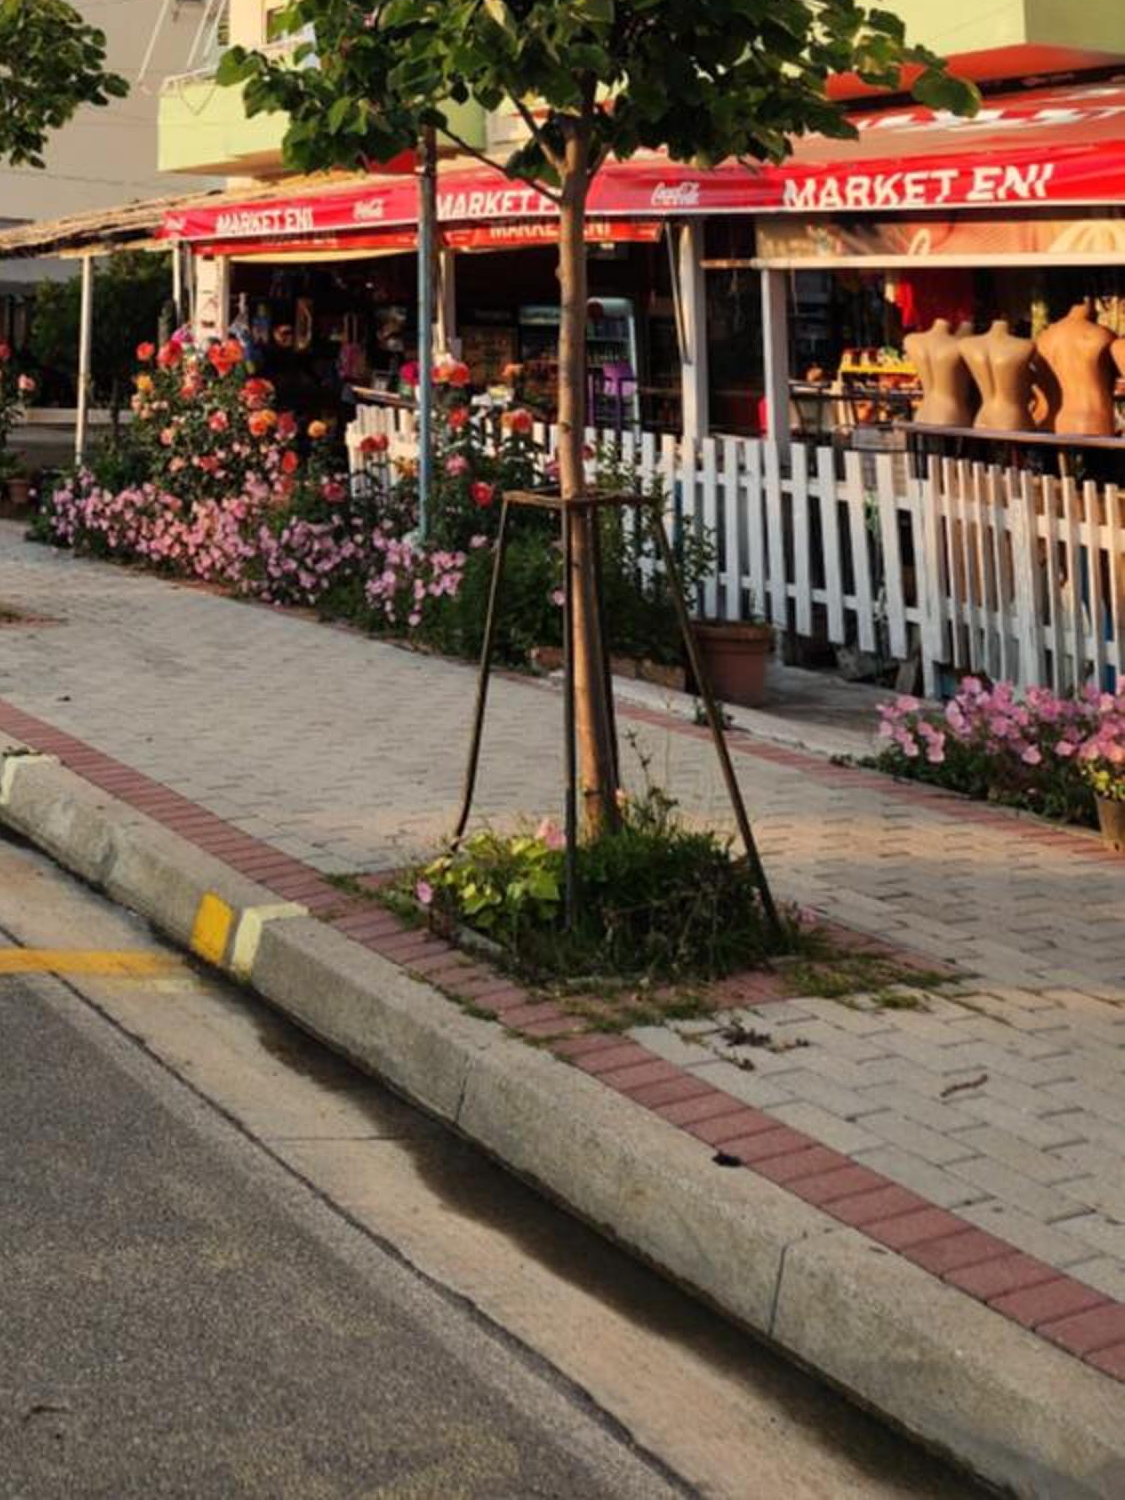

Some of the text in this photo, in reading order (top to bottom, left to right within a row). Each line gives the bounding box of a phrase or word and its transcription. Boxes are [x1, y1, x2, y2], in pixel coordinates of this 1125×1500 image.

[783, 163, 1055, 211] MARKET ENI
[436, 188, 537, 220] MARKET
[216, 206, 313, 236] MARKET ENI
